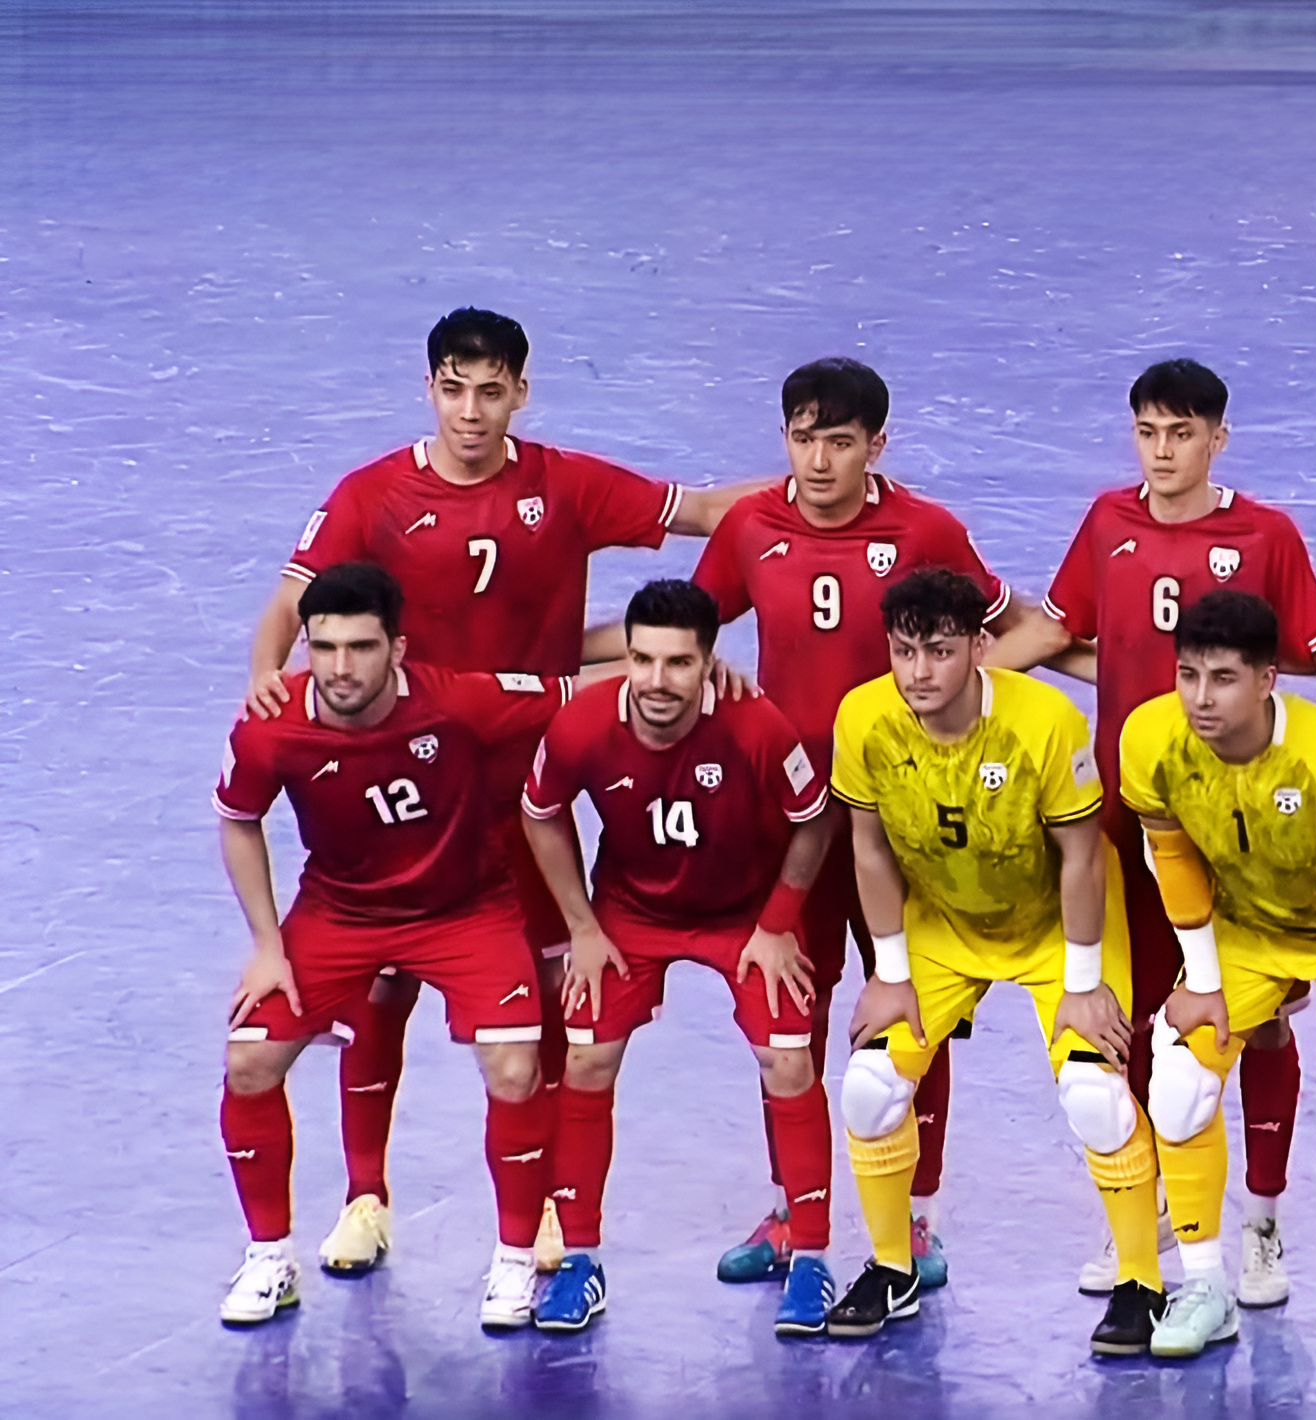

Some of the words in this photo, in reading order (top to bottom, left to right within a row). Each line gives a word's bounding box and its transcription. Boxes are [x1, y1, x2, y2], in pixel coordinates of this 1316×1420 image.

[468, 539, 497, 593] 7
[812, 575, 841, 630] 9
[1152, 576, 1180, 632] 6
[365, 778, 428, 825] 12
[645, 797, 700, 848] 14
[936, 803, 968, 850] 5
[1231, 809, 1250, 853] 1
